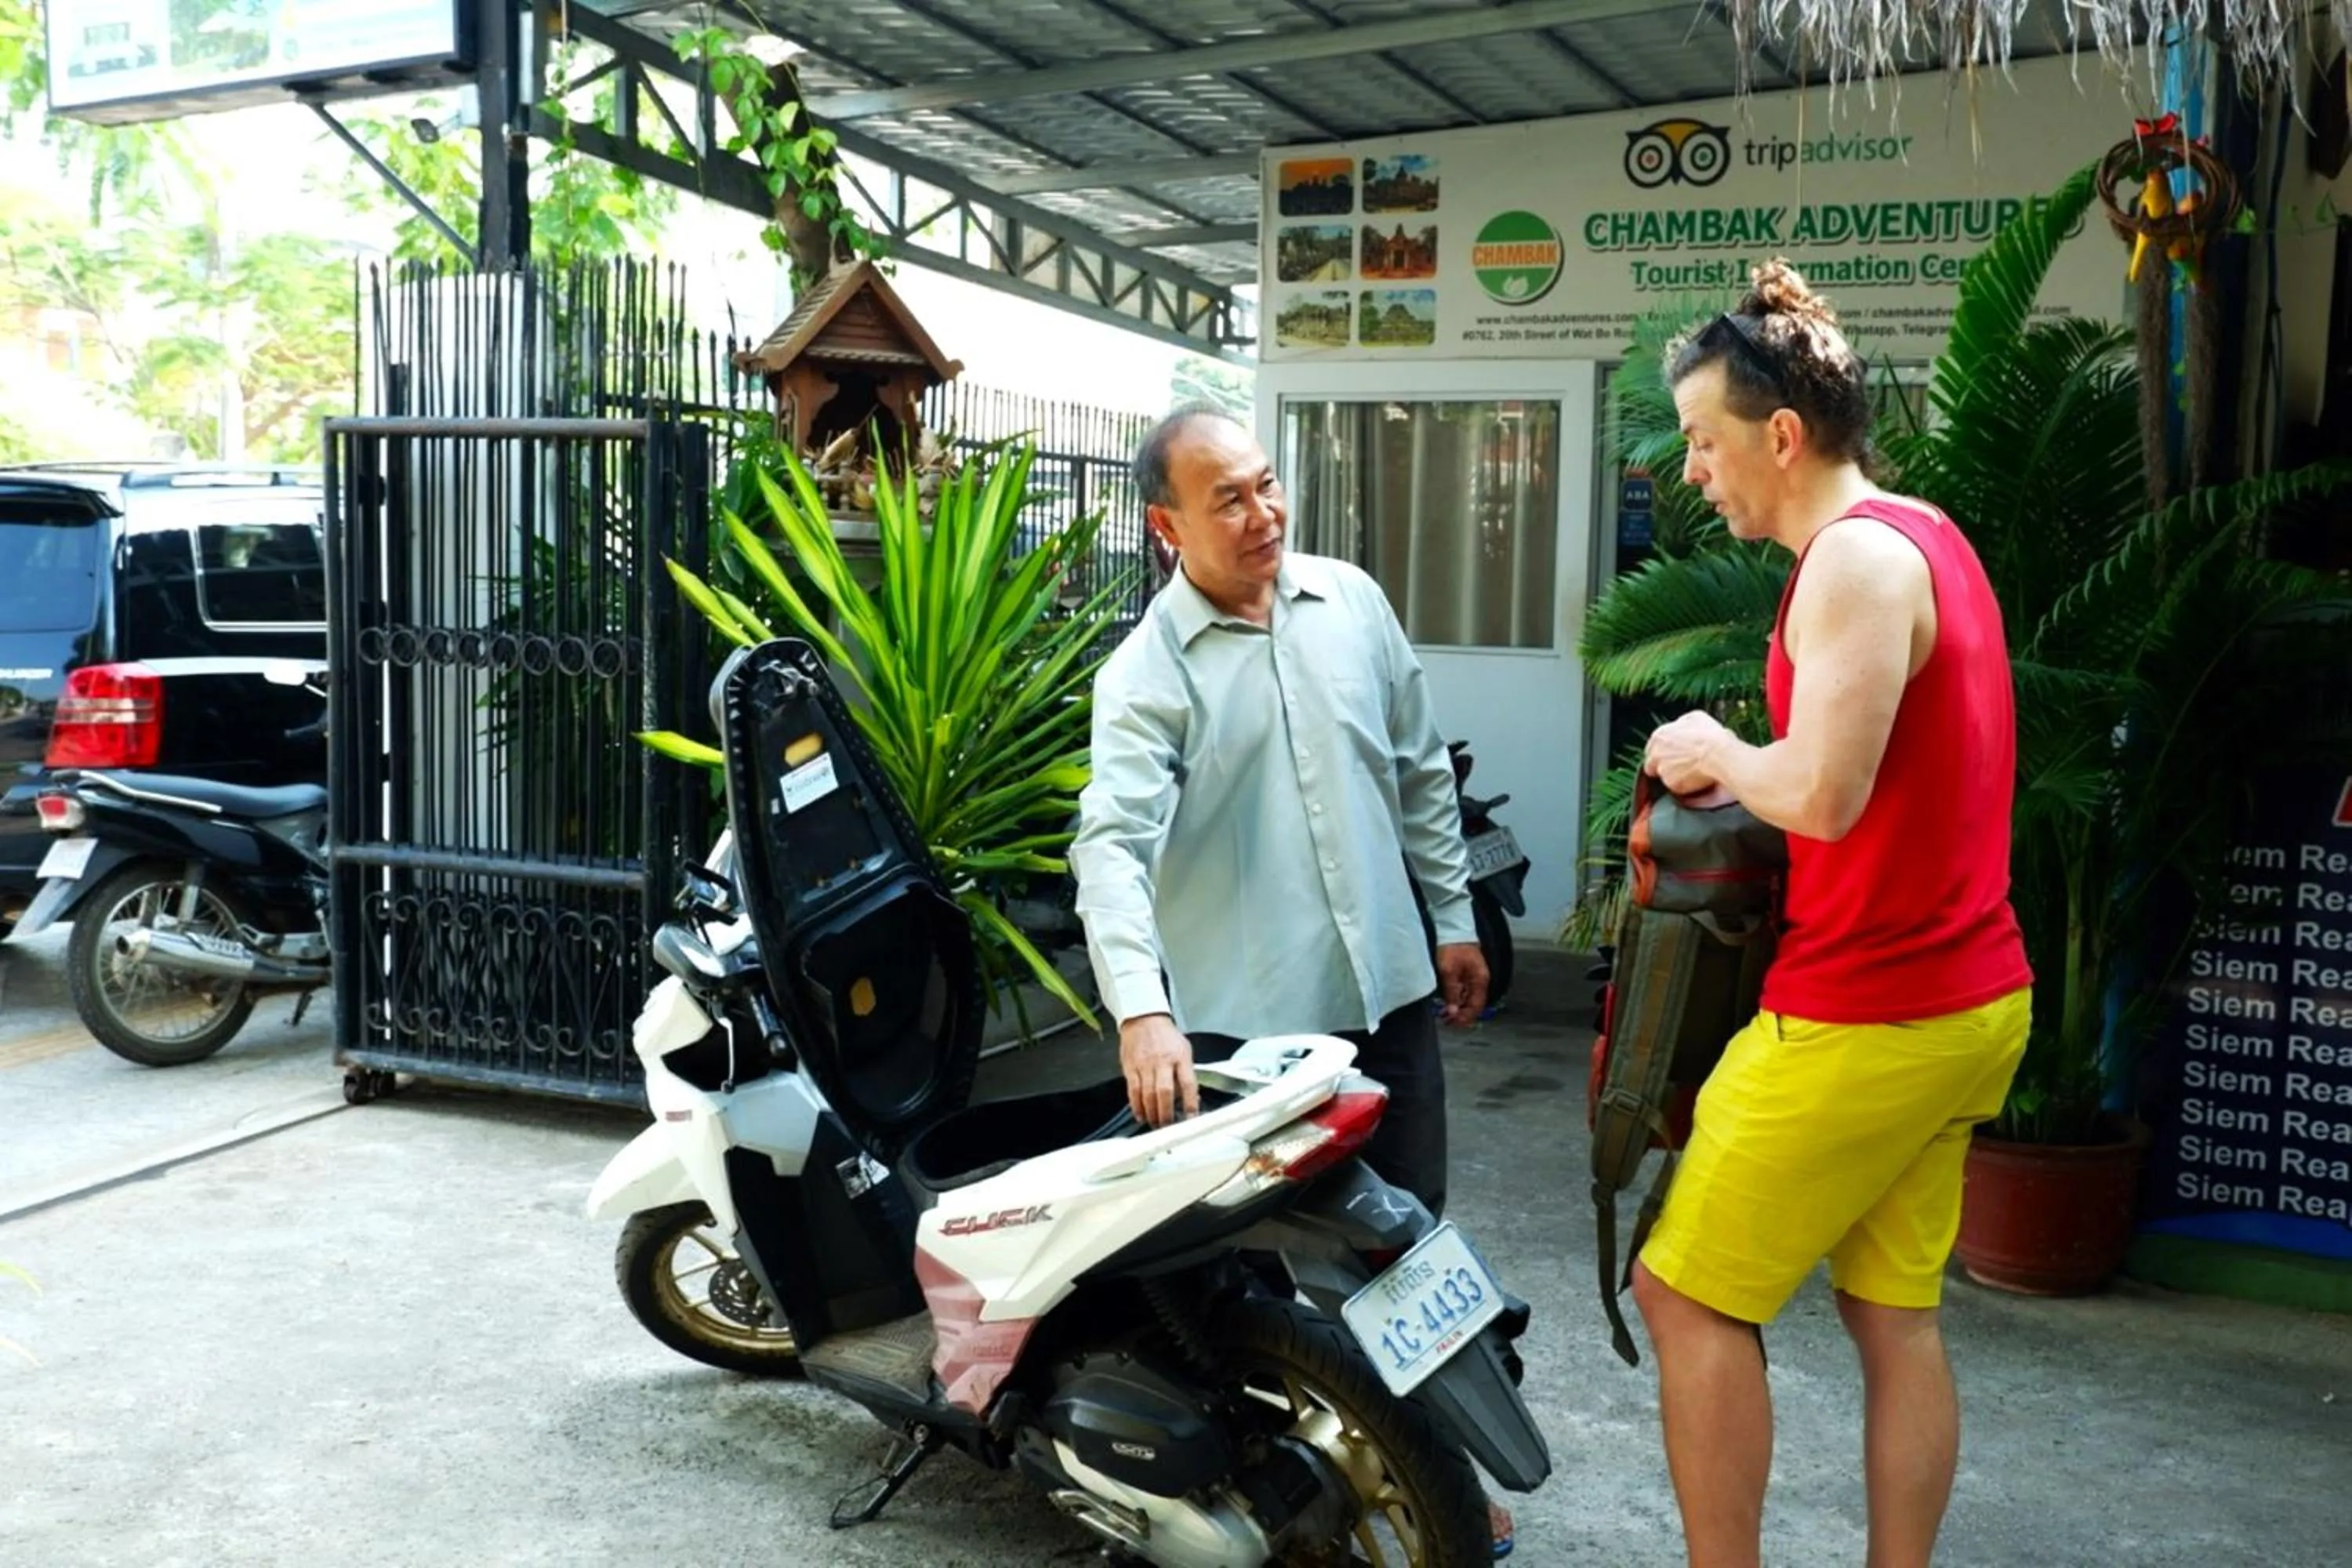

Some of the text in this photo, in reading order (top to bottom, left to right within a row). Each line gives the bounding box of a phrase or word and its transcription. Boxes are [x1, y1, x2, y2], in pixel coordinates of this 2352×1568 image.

[1744, 132, 1913, 172] tripadvisor
[1584, 198, 2056, 247] CHAMBAK ADVENTUR
[1473, 241, 1557, 267] CHAMBAK
[1631, 259, 1727, 286] Tourist
[1737, 253, 1910, 284] Irmation
[1524, 328, 1556, 340] Street
[1559, 327, 1570, 339] of
[1572, 327, 1593, 339] Wat
[2300, 844, 2352, 873] Re
[2190, 949, 2279, 982] Siem
[2187, 986, 2276, 1020] Siem
[2185, 1024, 2274, 1058] Siem
[2183, 1061, 2271, 1095] Siem
[2180, 1098, 2270, 1134] Siem
[2179, 1134, 2267, 1170] Siem
[2176, 1172, 2352, 1227] Siem Rea
[1381, 1267, 1483, 1370] 1C-4433
